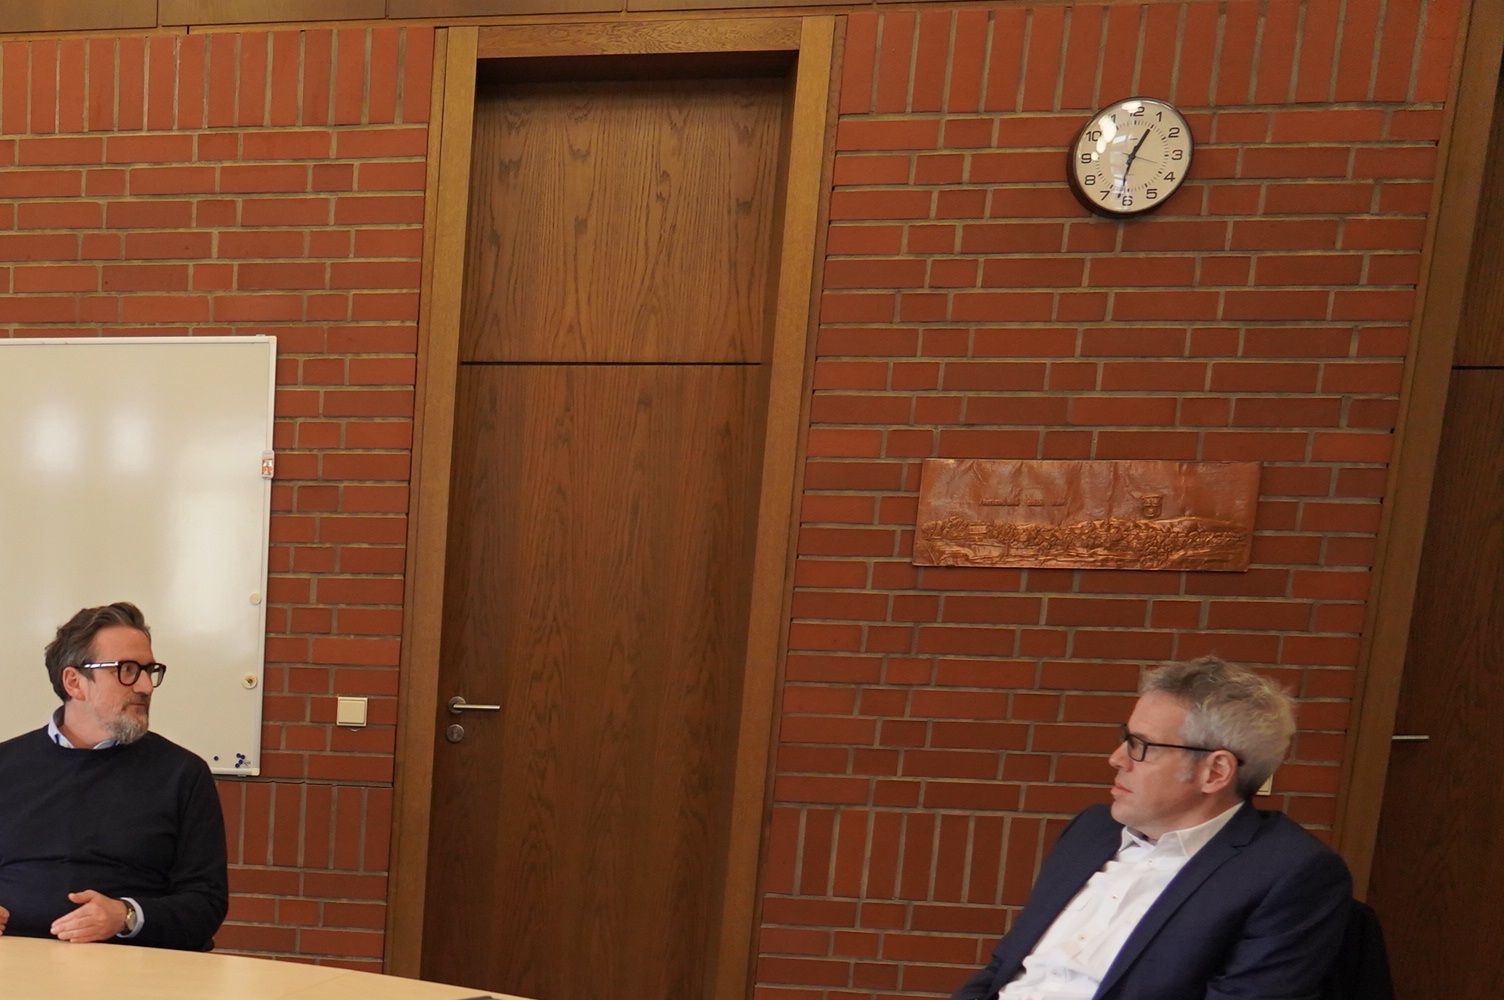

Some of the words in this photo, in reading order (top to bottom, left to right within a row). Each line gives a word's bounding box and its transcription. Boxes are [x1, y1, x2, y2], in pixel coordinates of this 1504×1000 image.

[1129, 106, 1146, 117] 2
[1156, 111, 1163, 122] 1
[1085, 130, 1102, 142] 10
[1168, 127, 1181, 138] 2
[1080, 153, 1092, 164] 9
[1171, 149, 1183, 161] 3
[1084, 174, 1096, 186] 8
[1163, 171, 1176, 182] 4
[1100, 190, 1111, 201] 7
[1146, 188, 1158, 199] 5
[1121, 195, 1133, 207] 6
